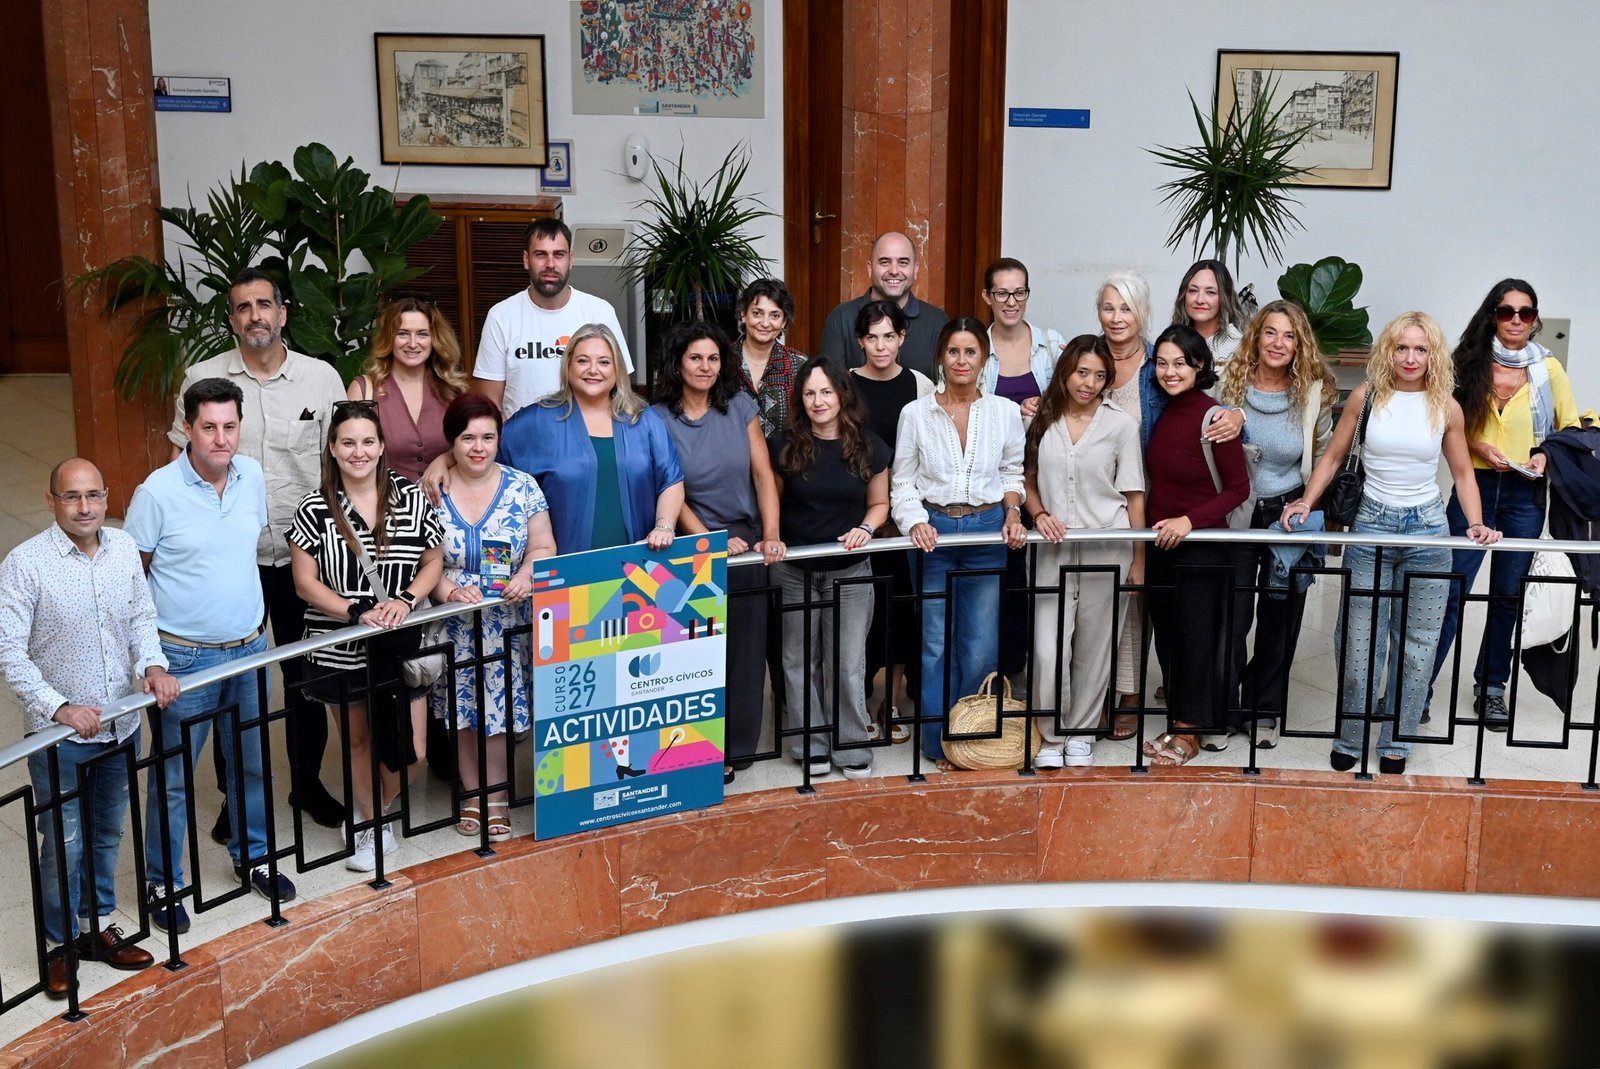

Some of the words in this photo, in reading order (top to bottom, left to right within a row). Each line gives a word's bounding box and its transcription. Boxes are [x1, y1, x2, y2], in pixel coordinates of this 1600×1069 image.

[514, 342, 566, 360] elles
[568, 660, 596, 687] 26
[630, 676, 674, 690] CENTROS
[676, 668, 714, 682] CÍVICOS
[555, 666, 566, 712] CURSO
[568, 684, 596, 710] 27
[630, 686, 665, 697] SANTANDER
[543, 693, 717, 748] ACTIVIDADES
[622, 786, 658, 798] SANTANDER
[579, 801, 682, 826] www.centroscivicossantander.com
